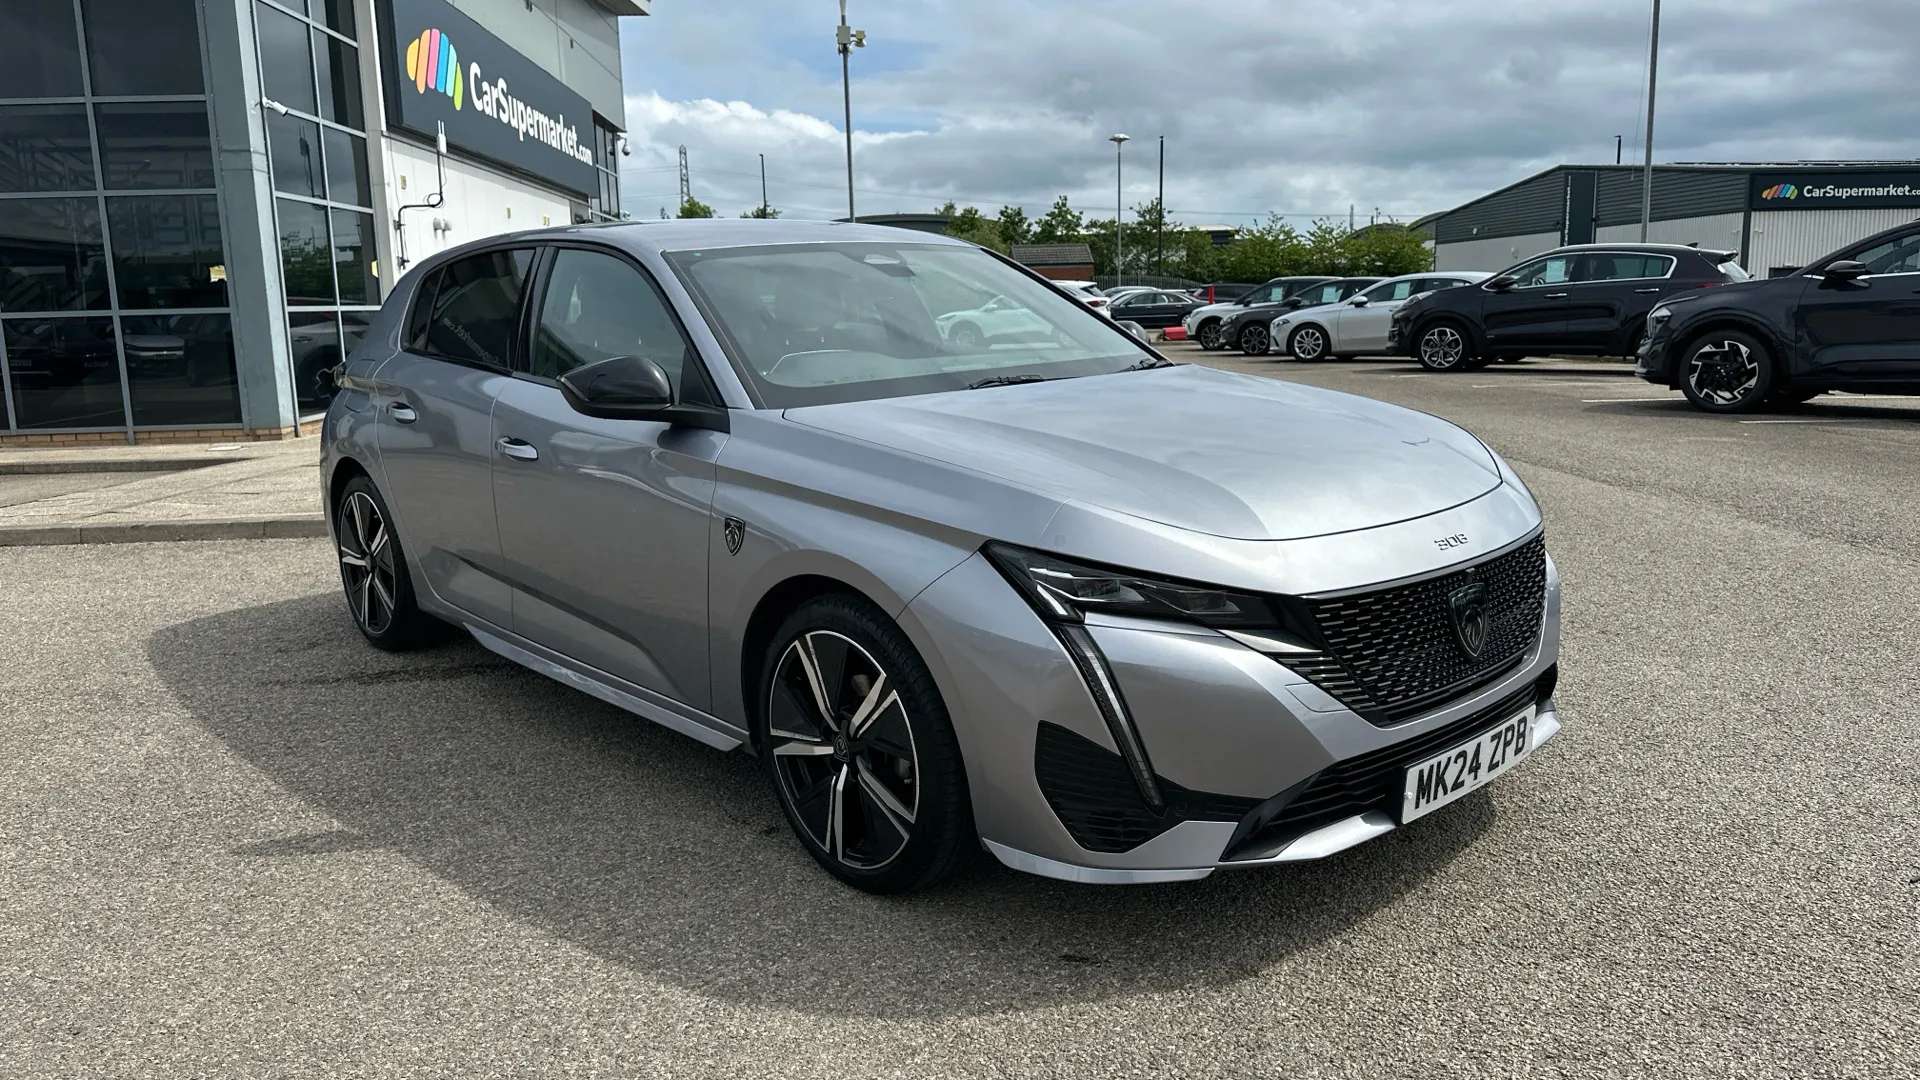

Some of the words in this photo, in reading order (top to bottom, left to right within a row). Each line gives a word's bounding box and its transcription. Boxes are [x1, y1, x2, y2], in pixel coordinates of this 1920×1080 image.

[469, 62, 593, 166] CarSupermarket.com
[1414, 741, 1482, 810] MK24
[1487, 714, 1527, 776] ZPB
